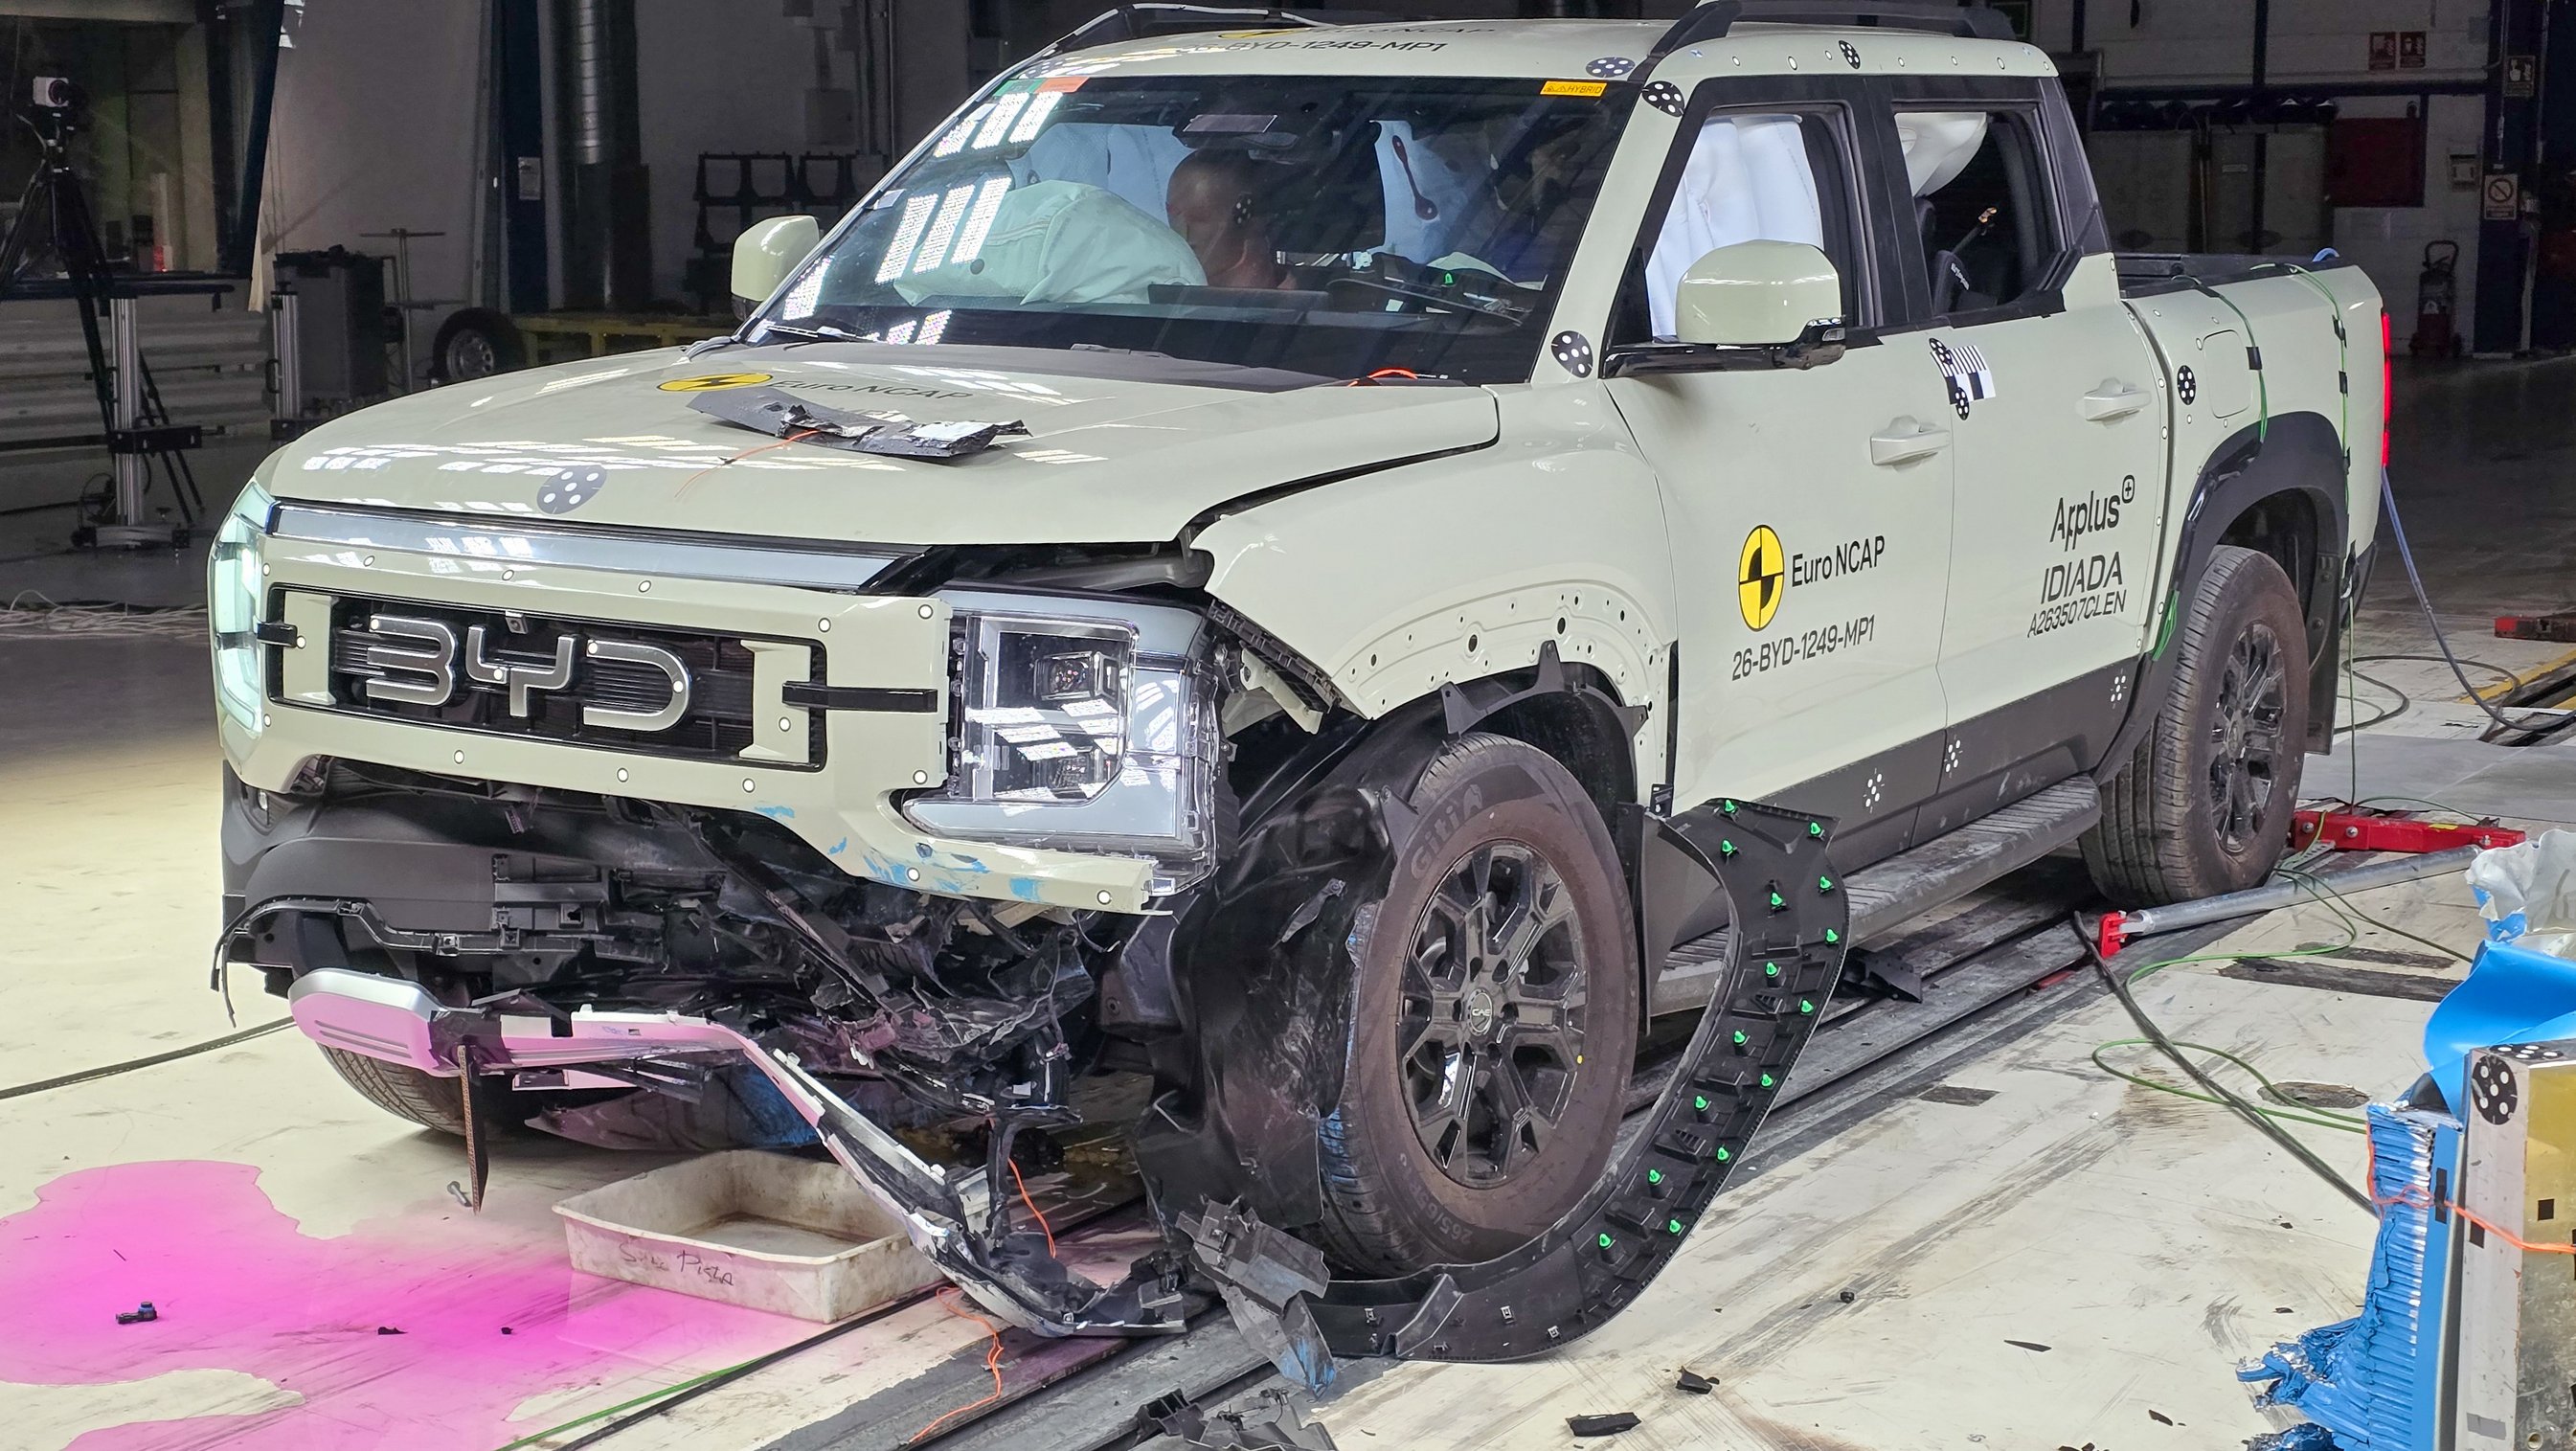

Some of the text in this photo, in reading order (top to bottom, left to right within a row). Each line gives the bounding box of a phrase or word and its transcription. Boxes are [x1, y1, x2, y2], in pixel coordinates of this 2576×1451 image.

[1567, 84, 1603, 94] HYBRID
[768, 380, 973, 399] Euro NCAP
[1792, 534, 1886, 588] Euro NCAP
[2040, 551, 2123, 605] IDIADA
[2026, 588, 2127, 639] A263507CLEN
[366, 613, 692, 733] BYD
[1731, 613, 1876, 682] 26-BYD-1249-MP1
